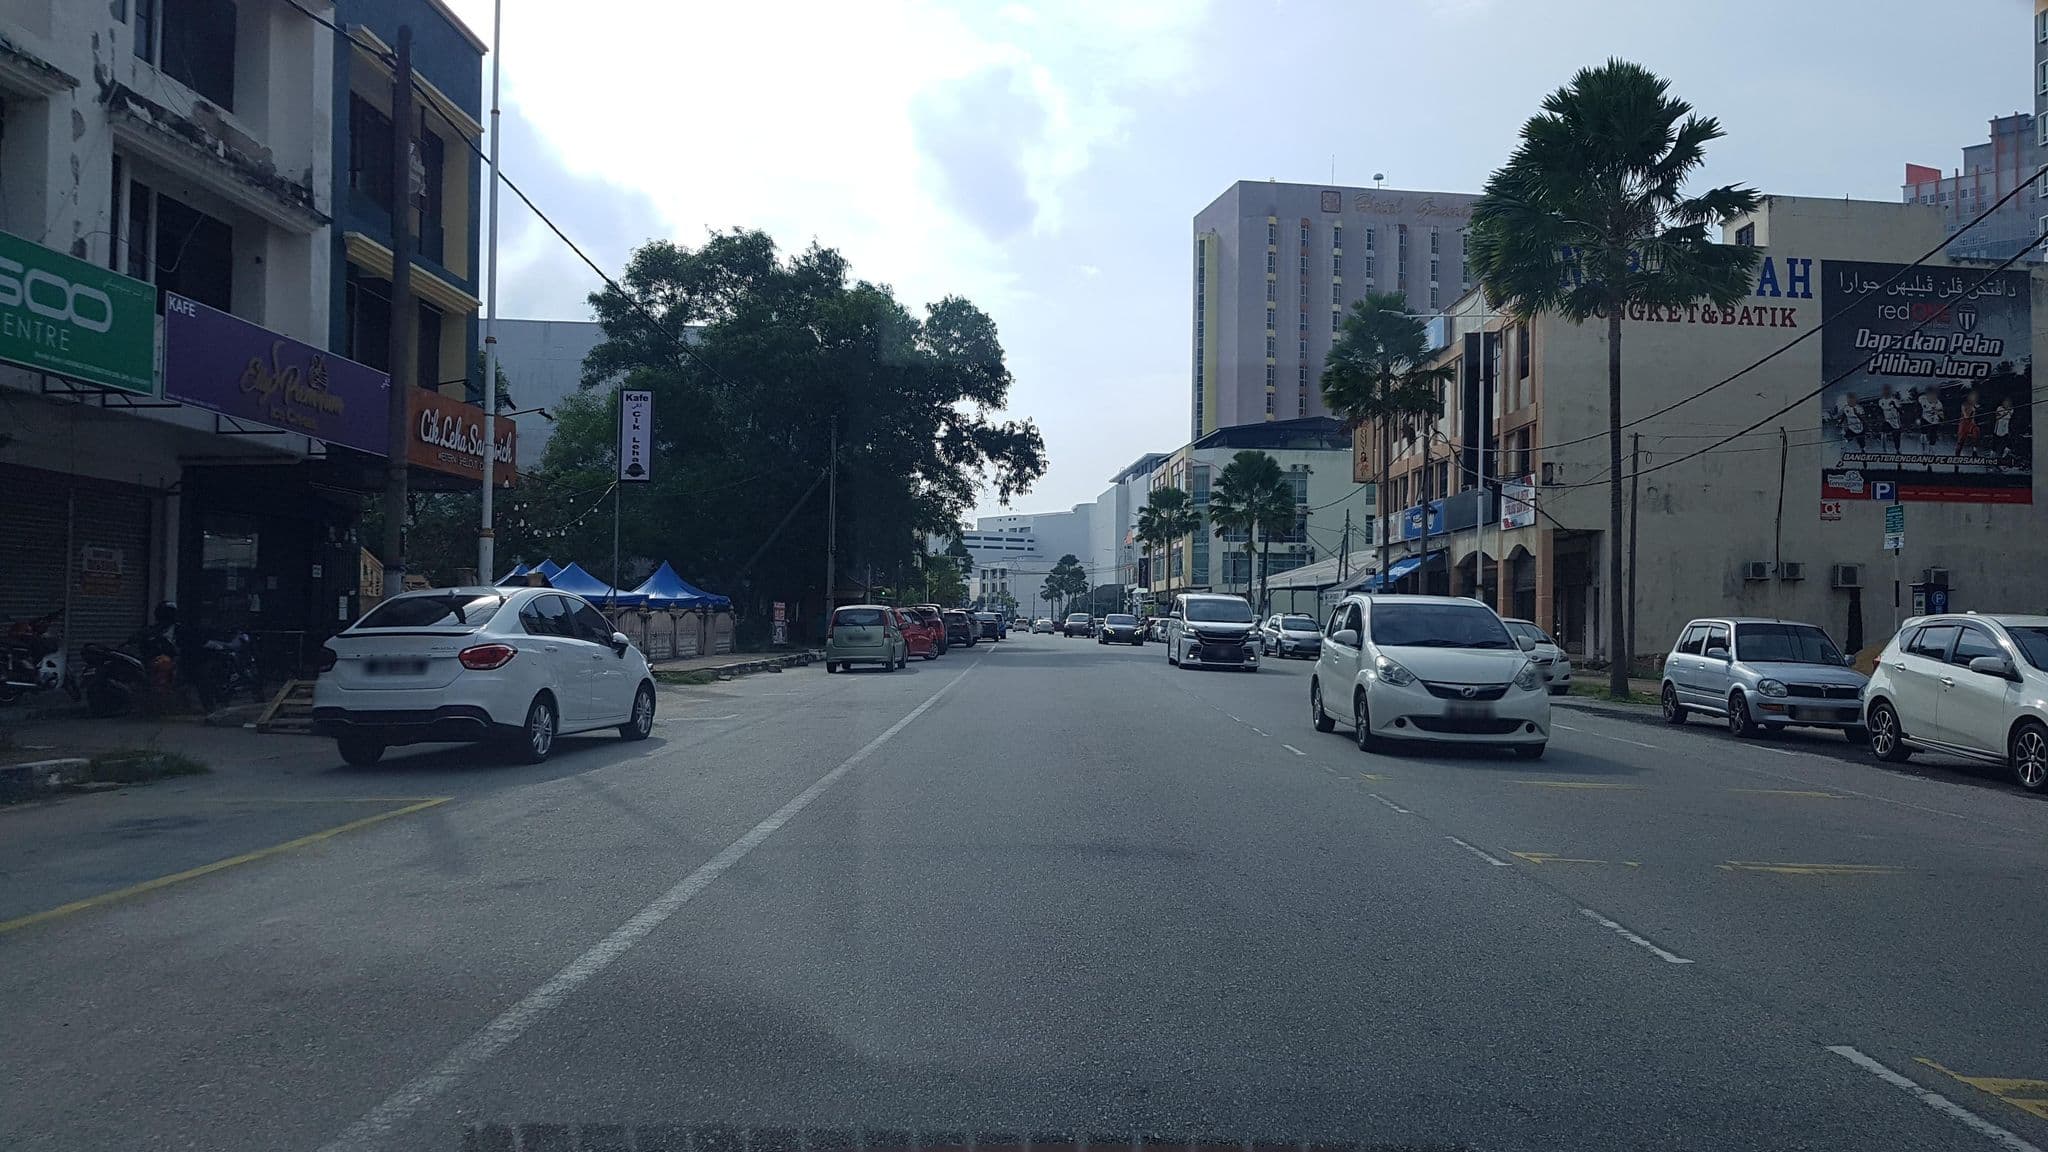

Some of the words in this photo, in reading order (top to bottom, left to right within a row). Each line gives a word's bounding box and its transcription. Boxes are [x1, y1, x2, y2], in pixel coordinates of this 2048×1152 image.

[168, 297, 196, 318] KAFE
[1949, 333, 2001, 354] Pelan
[1868, 352, 1933, 375] Pilihan
[1935, 356, 1990, 377] Juara
[626, 394, 649, 402] Kafe
[421, 408, 440, 445] Cik
[440, 416, 467, 453] Leha
[1876, 483, 1890, 499] P
